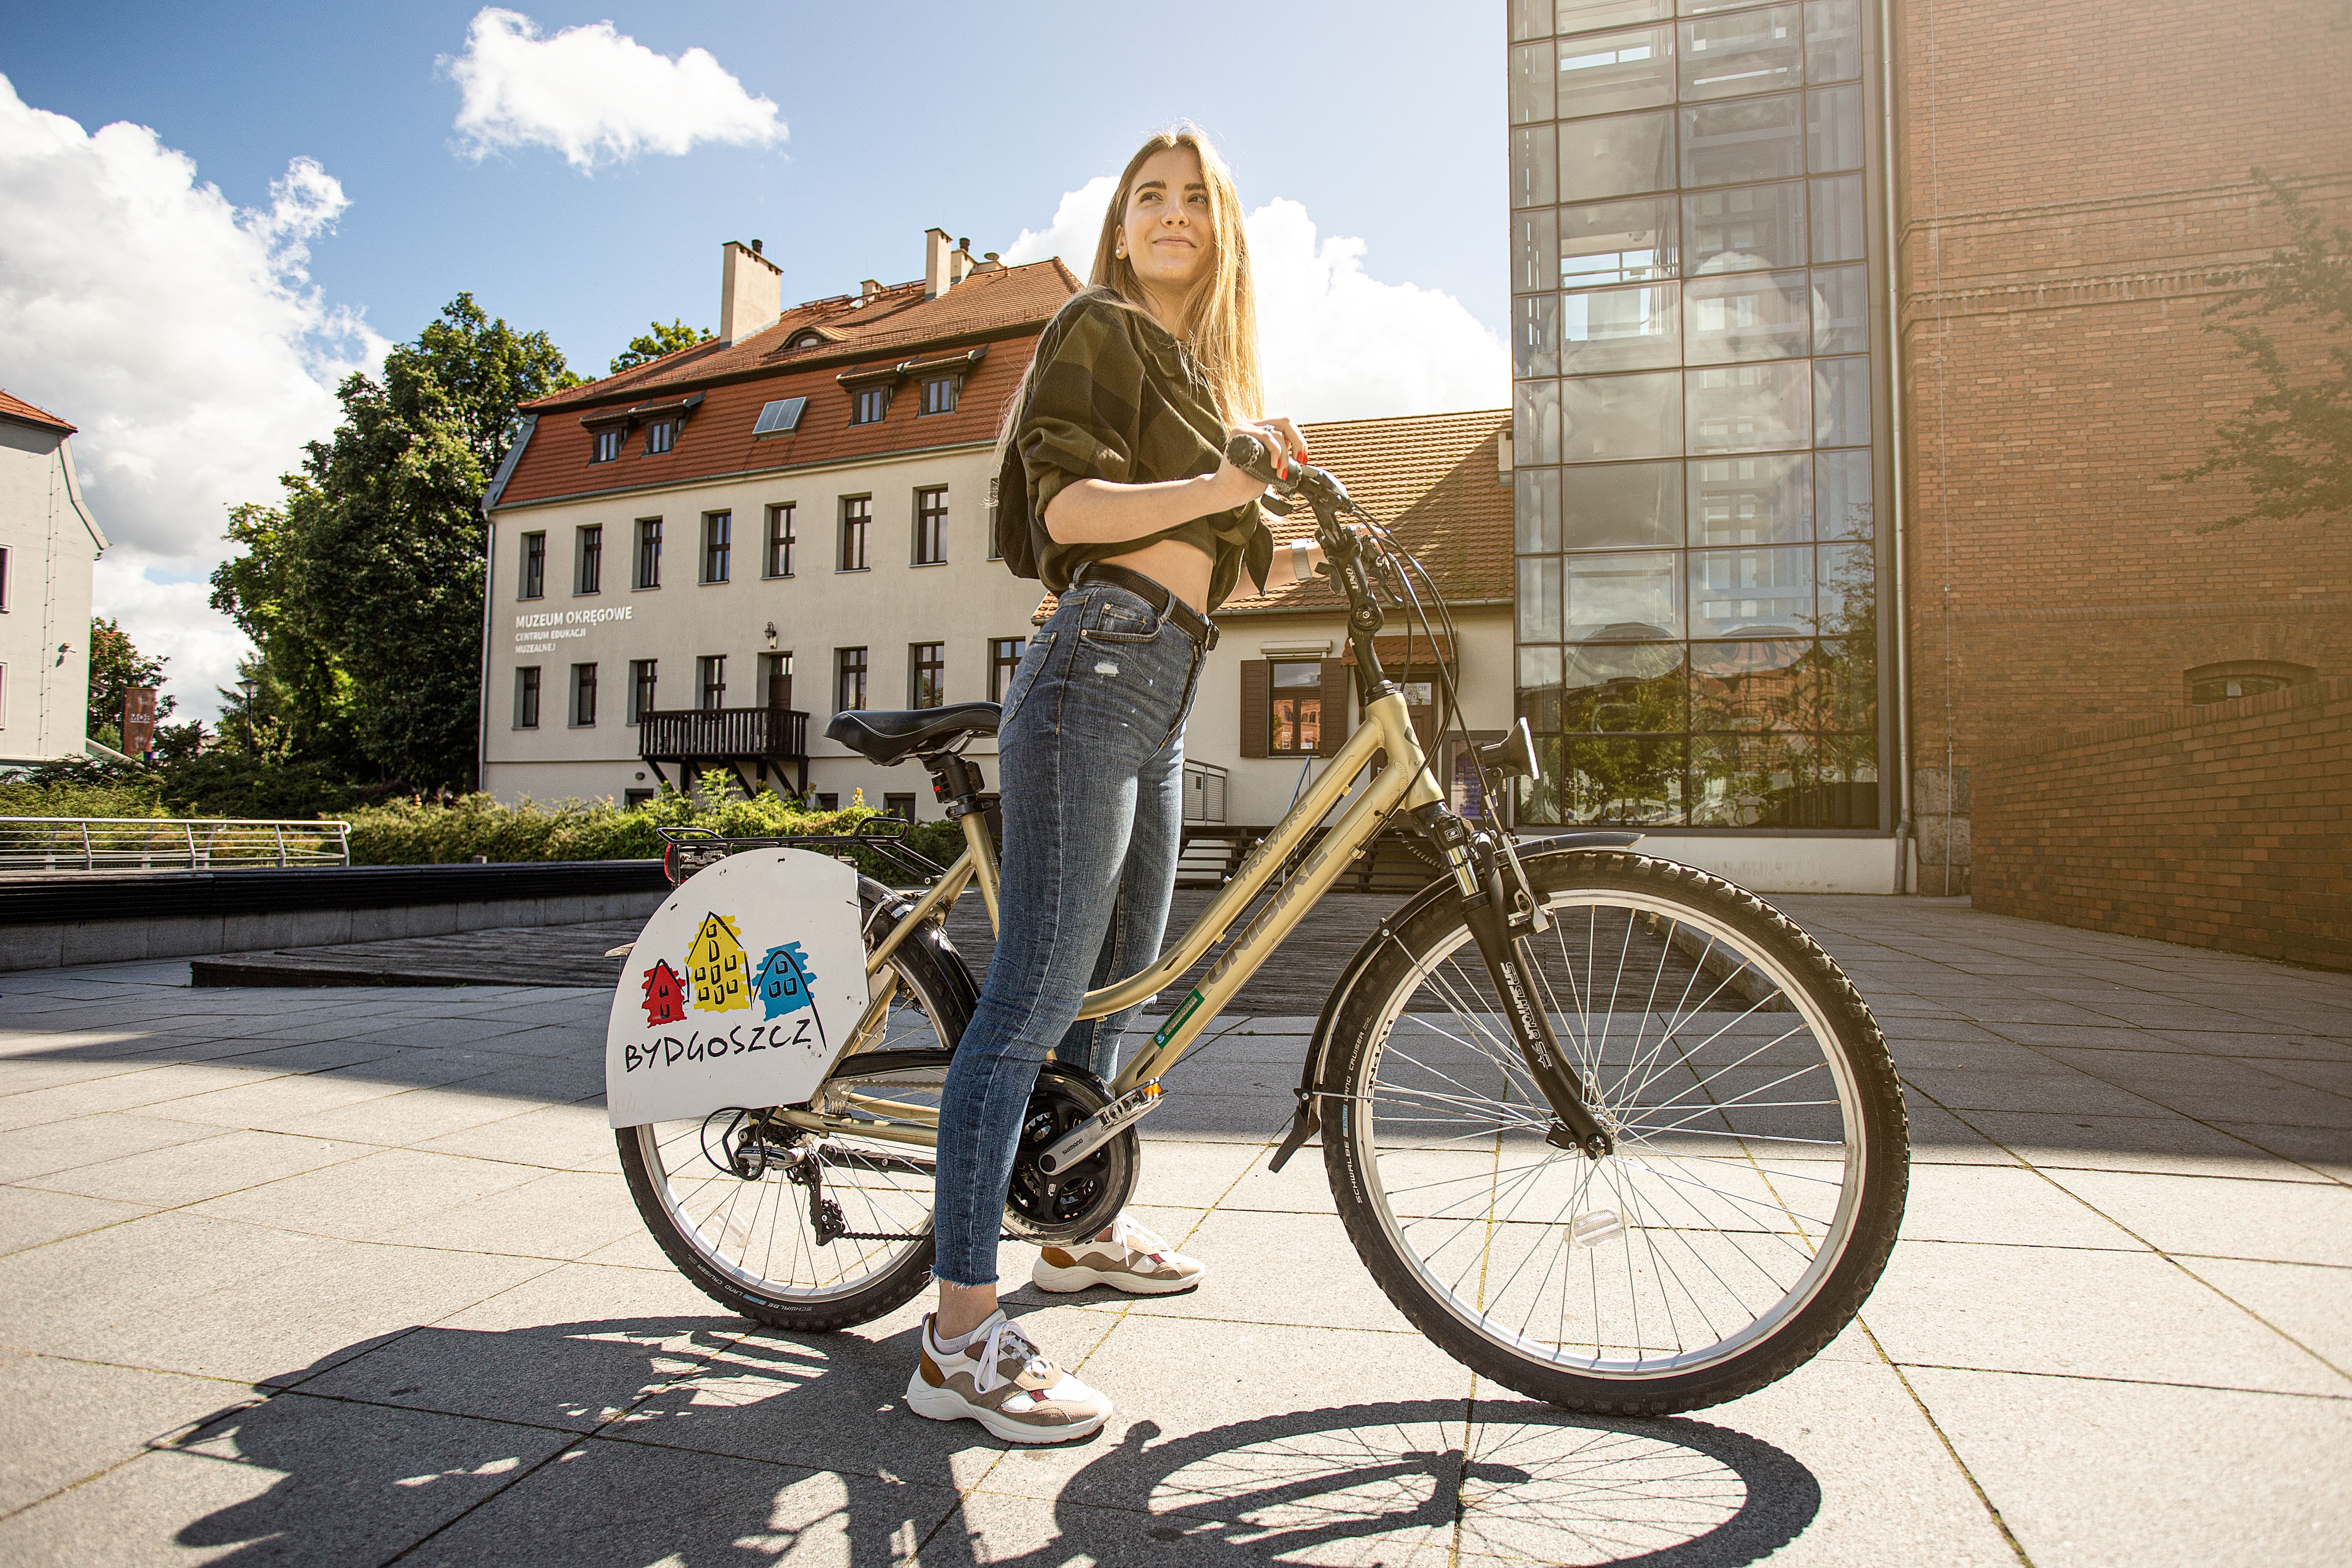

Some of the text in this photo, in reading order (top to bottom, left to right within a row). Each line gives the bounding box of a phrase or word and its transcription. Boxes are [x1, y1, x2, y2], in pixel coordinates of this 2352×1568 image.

[1346, 567, 1359, 589] UNO
[516, 606, 633, 628] MUZEUM OKRĘGOWE
[515, 628, 586, 642] CENTRUM EDUKACJI
[515, 642, 556, 653] MUZEALNEJ
[1238, 802, 1308, 882] TRAWERS
[1207, 842, 1328, 986] UNIBIKE
[1168, 1001, 1200, 1038] ROWER OZNAKOWANY
[1509, 985, 1540, 1040] SUNTOUR
[625, 1019, 812, 1073] BYDGOSZCZ
[1349, 1032, 1364, 1071] CRUISER
[1062, 1138, 1084, 1155] SHIMANO
[1344, 1141, 1363, 1204] SCHWALBE
[697, 1264, 723, 1285] CRUISER
[724, 1285, 743, 1296] LAND
[767, 1302, 813, 1311] SCHWALBE
